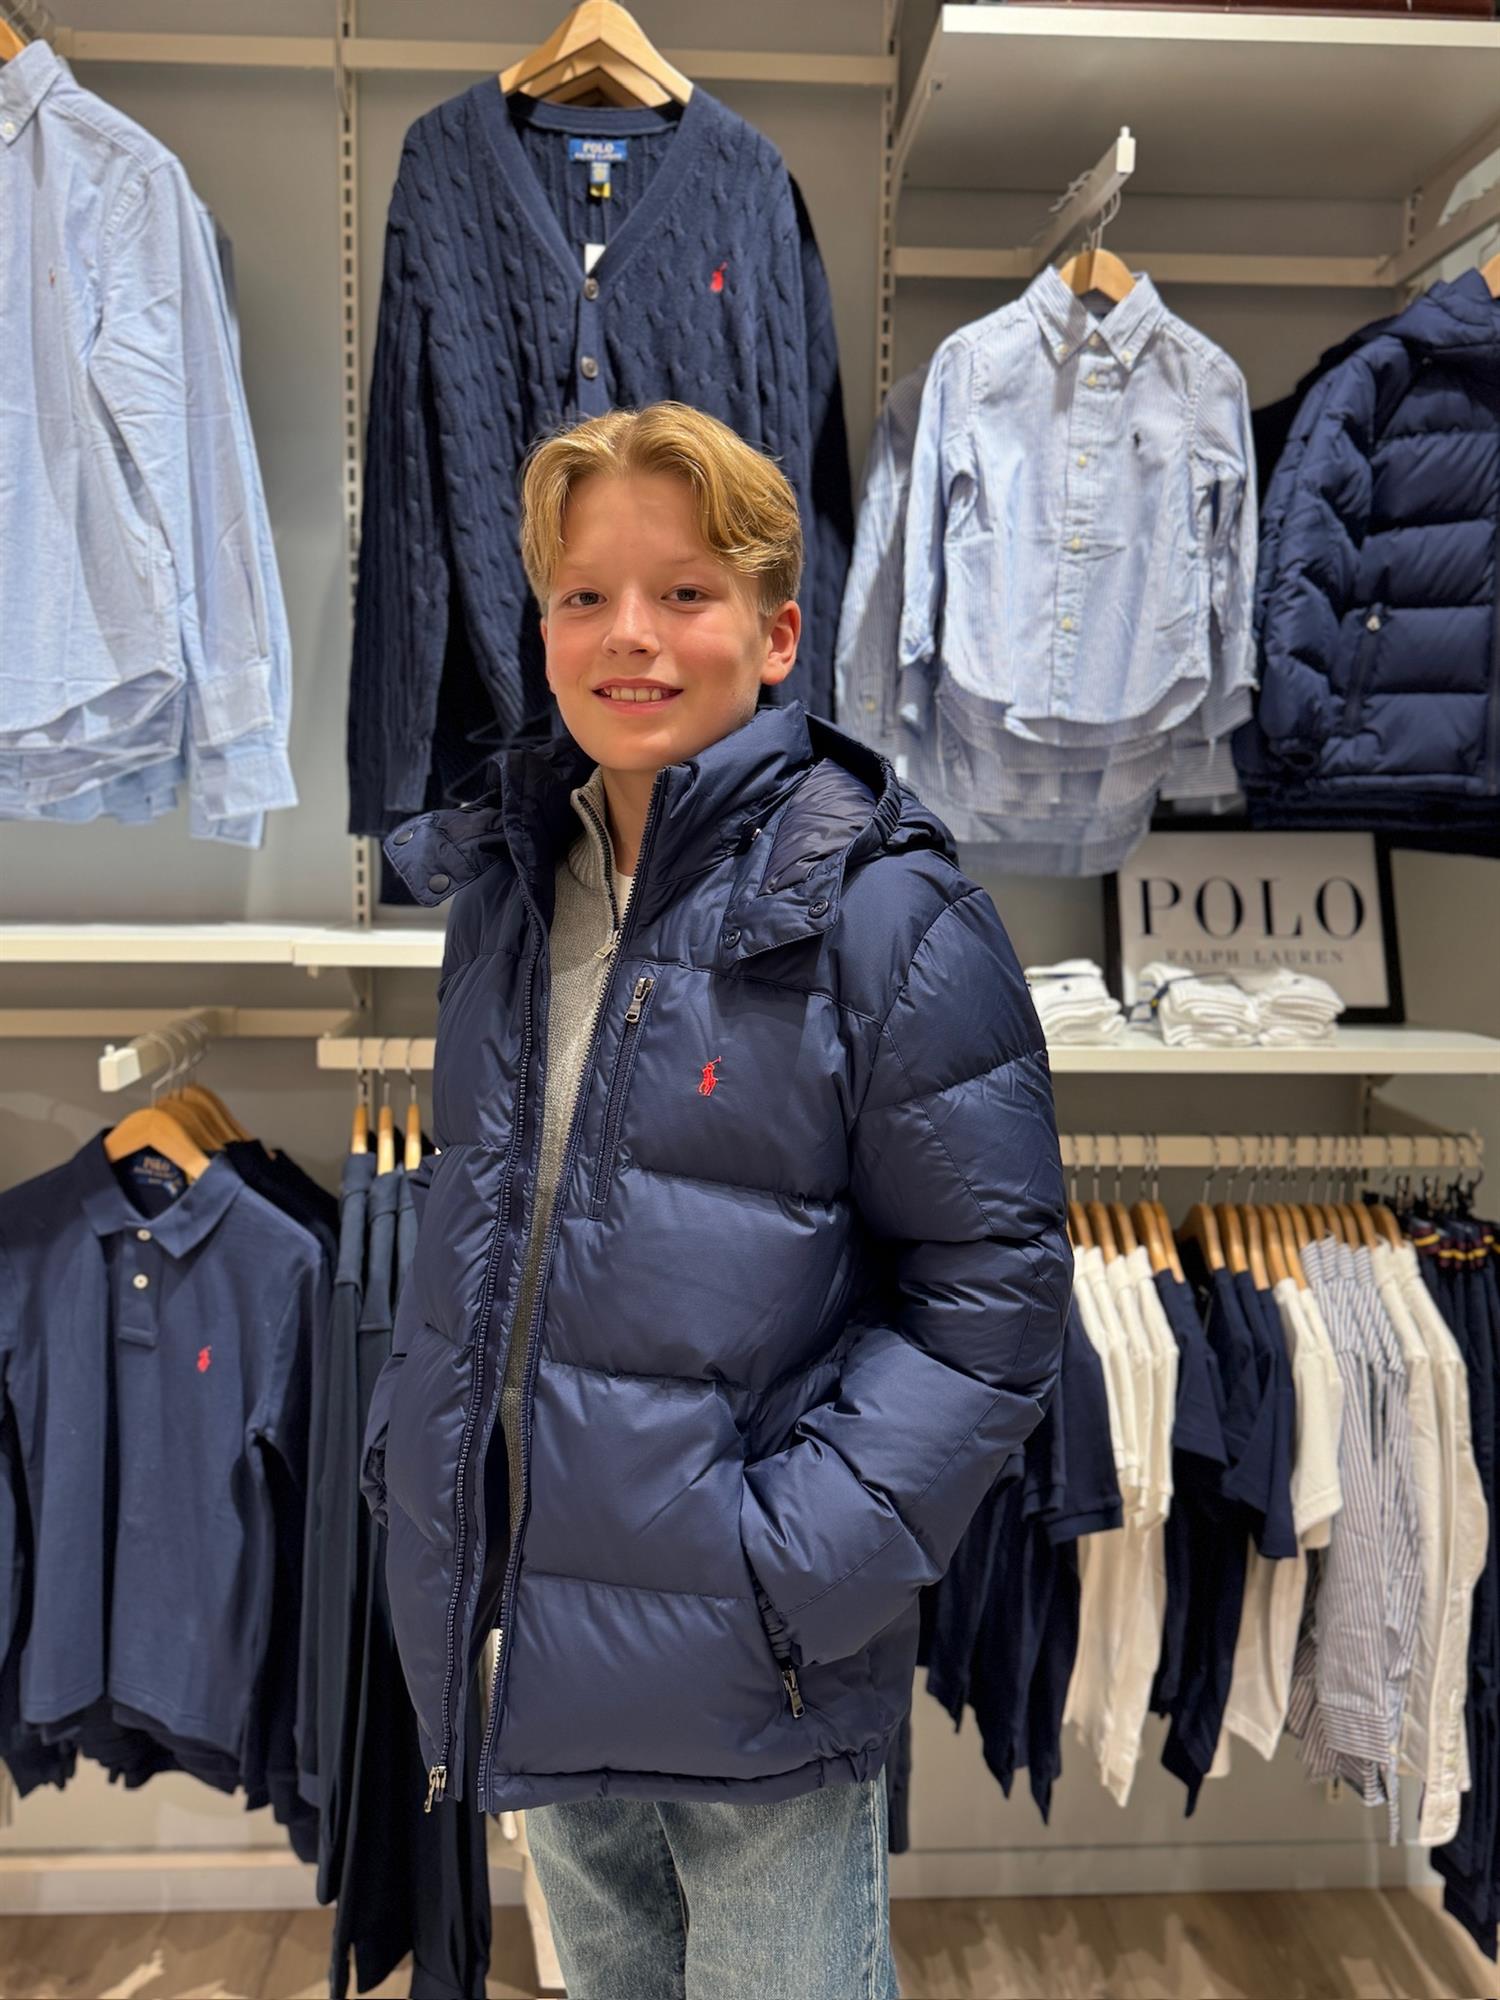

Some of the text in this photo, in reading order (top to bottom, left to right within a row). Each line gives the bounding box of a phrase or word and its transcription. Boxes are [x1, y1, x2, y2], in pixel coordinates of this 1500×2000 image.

[582, 142, 615, 154] POLO
[1138, 876, 1366, 940] POLO
[1165, 949, 1345, 965] RALPH LAUREN
